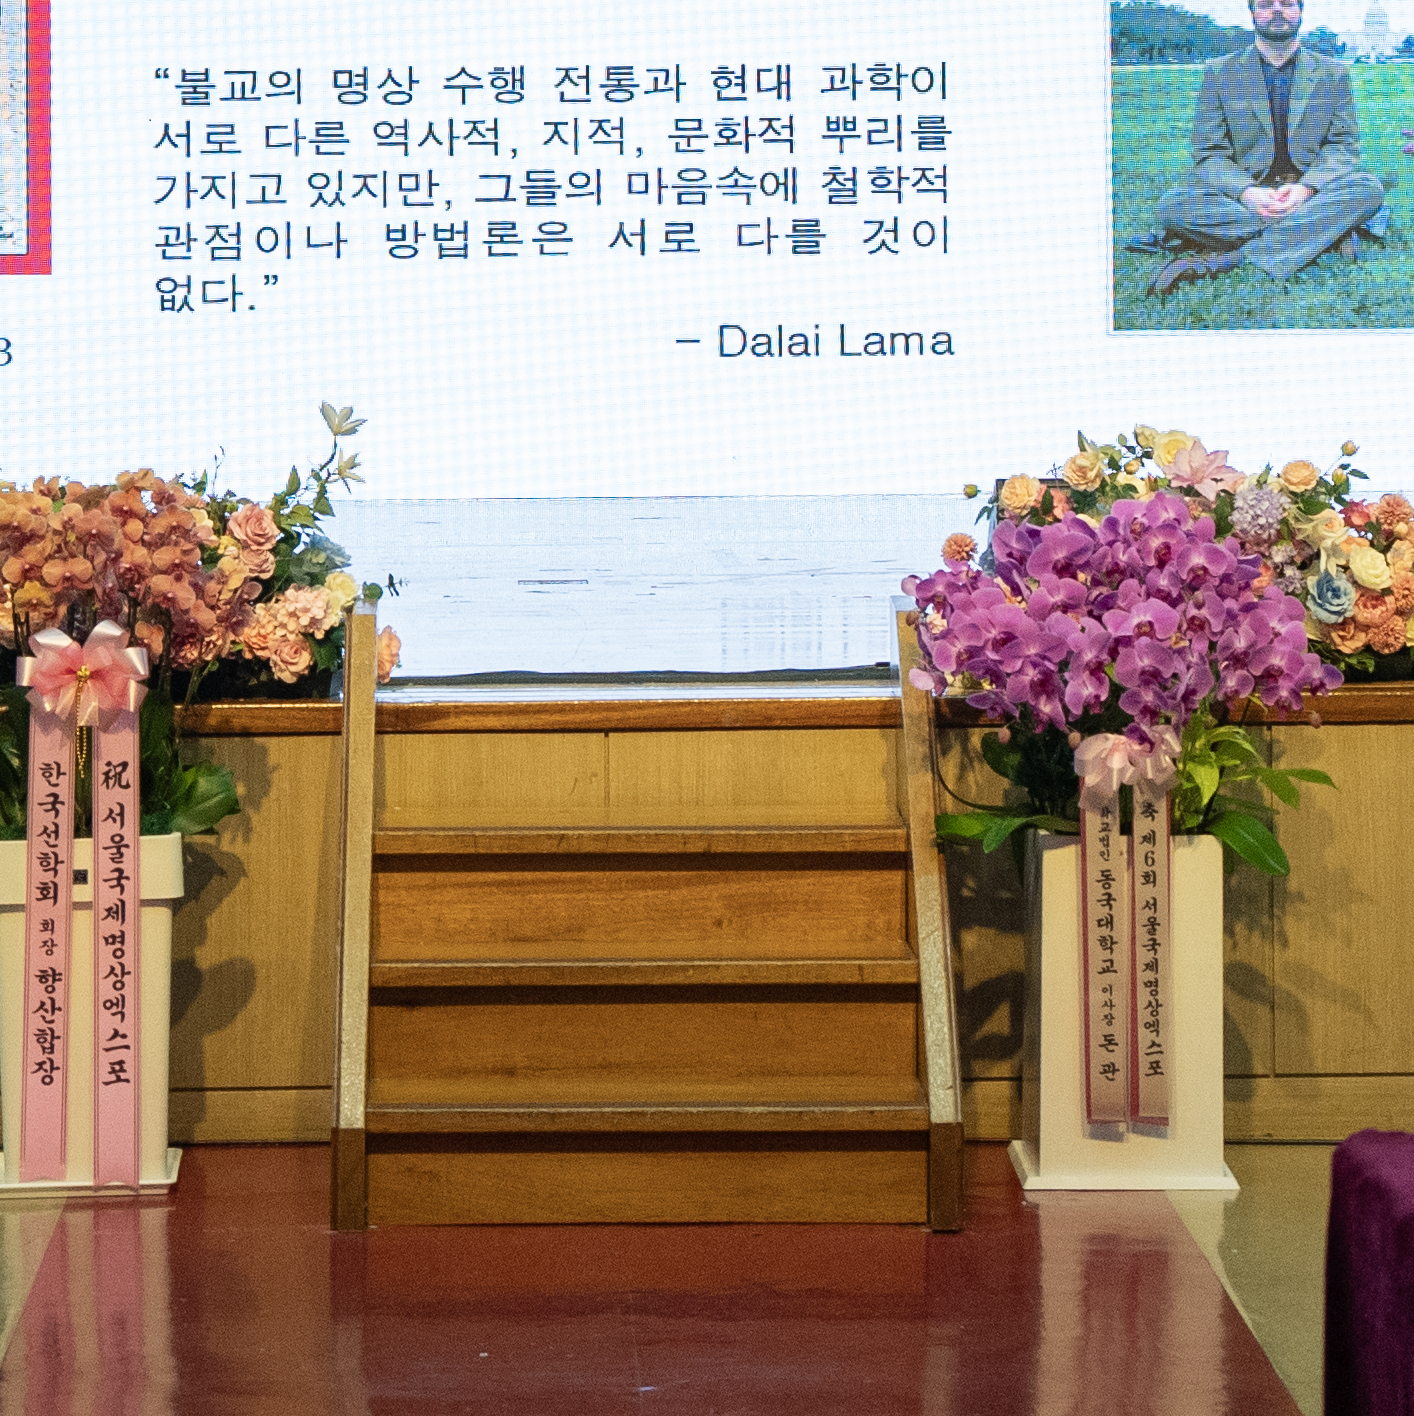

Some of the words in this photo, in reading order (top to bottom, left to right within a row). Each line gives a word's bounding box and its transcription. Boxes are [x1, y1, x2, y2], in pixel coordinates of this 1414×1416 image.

[332, 64, 421, 107] 명상
[442, 64, 526, 107] 수행
[554, 63, 688, 105] 전통과
[709, 63, 793, 103] 현대
[819, 60, 949, 103] 과학이
[153, 119, 243, 159] 서로
[264, 117, 351, 158] 다른
[372, 116, 519, 160] 역사적,
[542, 115, 644, 159] 지적,
[667, 113, 795, 155] 문화적
[821, 113, 953, 155] 뿌리를
[153, 170, 288, 210] 가지고
[306, 168, 453, 212] 있지만,
[474, 167, 603, 208] 그들의
[626, 165, 799, 207] 마음속에
[821, 163, 949, 206] 철학적
[154, 220, 349, 263] 관점이나
[384, 219, 574, 261] 방법론은
[608, 217, 701, 257] 서로
[736, 216, 828, 256] 다를
[862, 215, 949, 256] 것이
[718, 323, 821, 359] Dalai
[838, 322, 956, 358] Lama
[99, 759, 132, 791] 祝
[35, 759, 67, 908] 한국선학회
[1139, 801, 1159, 823] 축
[1139, 829, 1158, 889] 제6회
[38, 917, 58, 957] 회장
[100, 801, 132, 1087] 서울국제명상엑스포
[1095, 869, 1119, 976] 동국대학교
[1100, 984, 1116, 1027] 이사장
[1140, 895, 1166, 1079] 서울국제명상엑스포
[30, 965, 63, 1086] 향산합장
